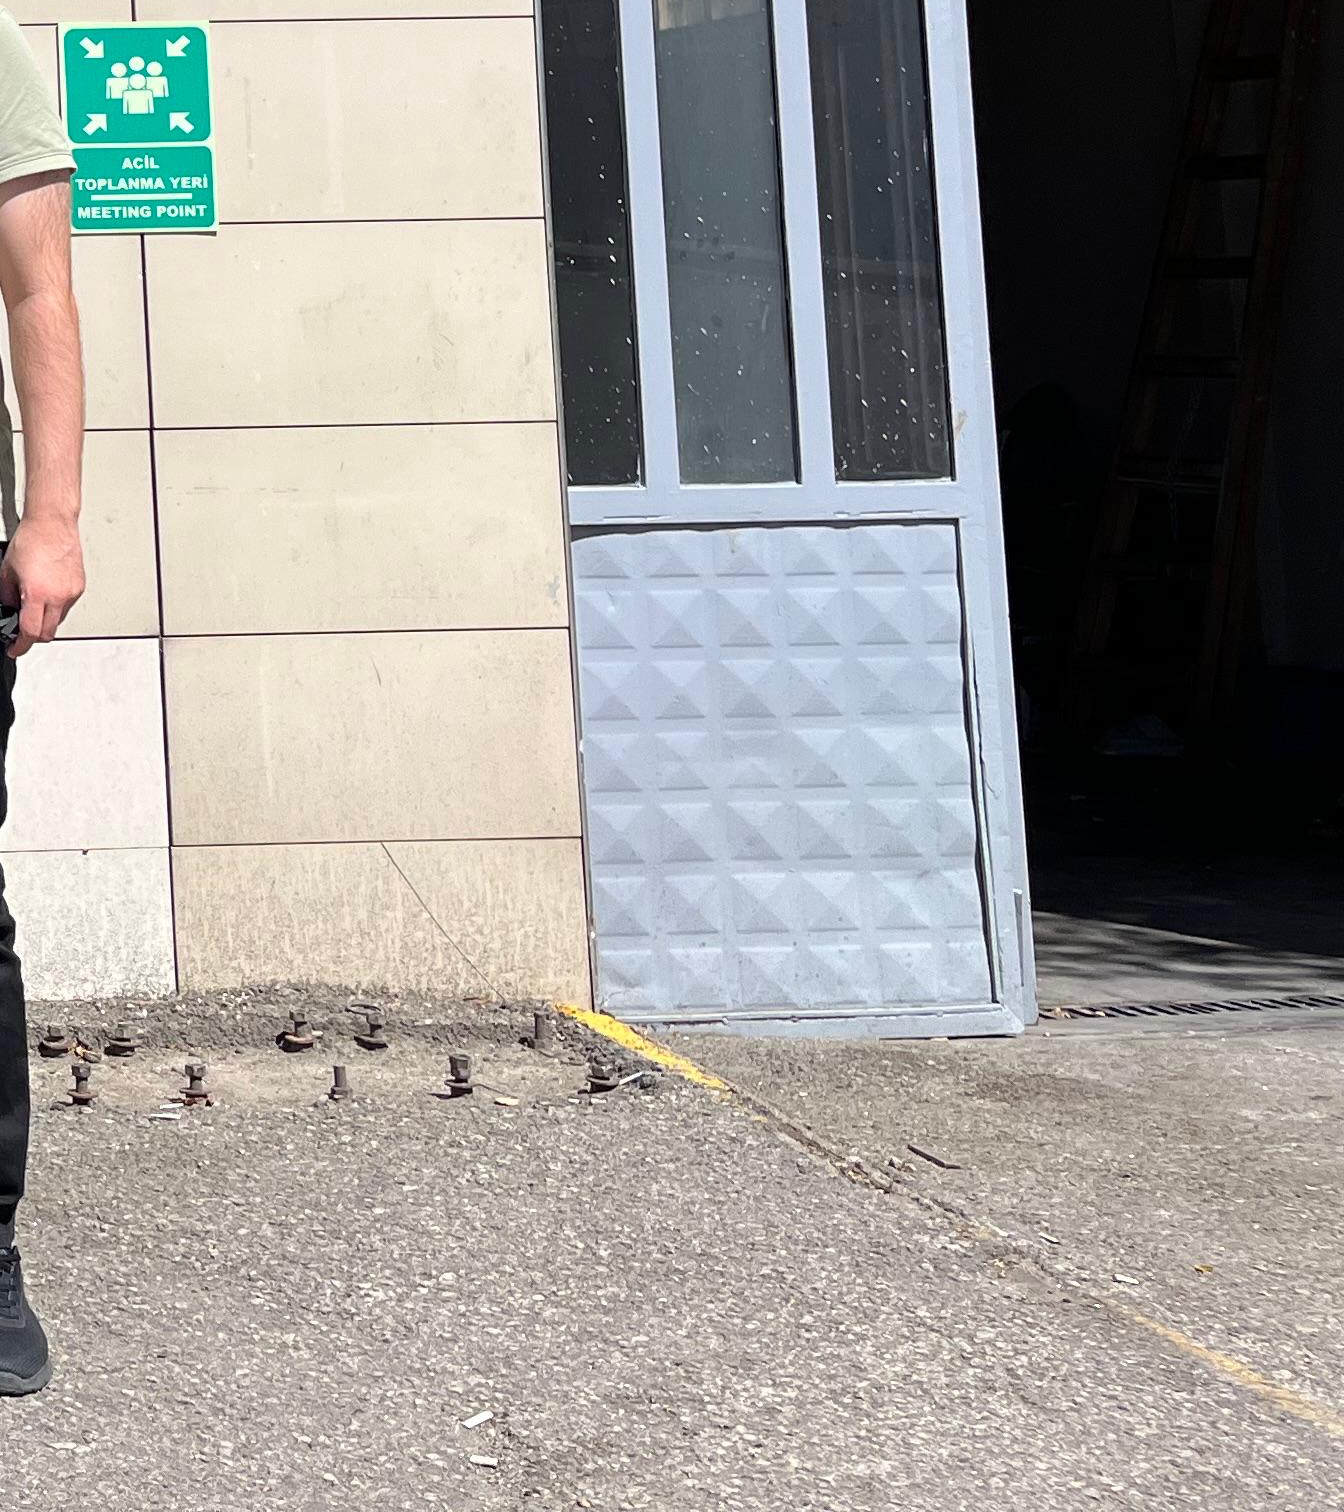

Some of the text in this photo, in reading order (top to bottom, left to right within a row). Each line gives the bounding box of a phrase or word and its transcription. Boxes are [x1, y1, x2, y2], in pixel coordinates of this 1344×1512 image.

[121, 155, 160, 170] ACİL
[75, 174, 208, 190] TOPLANMA YERİ
[78, 205, 207, 219] MEETING POINT
